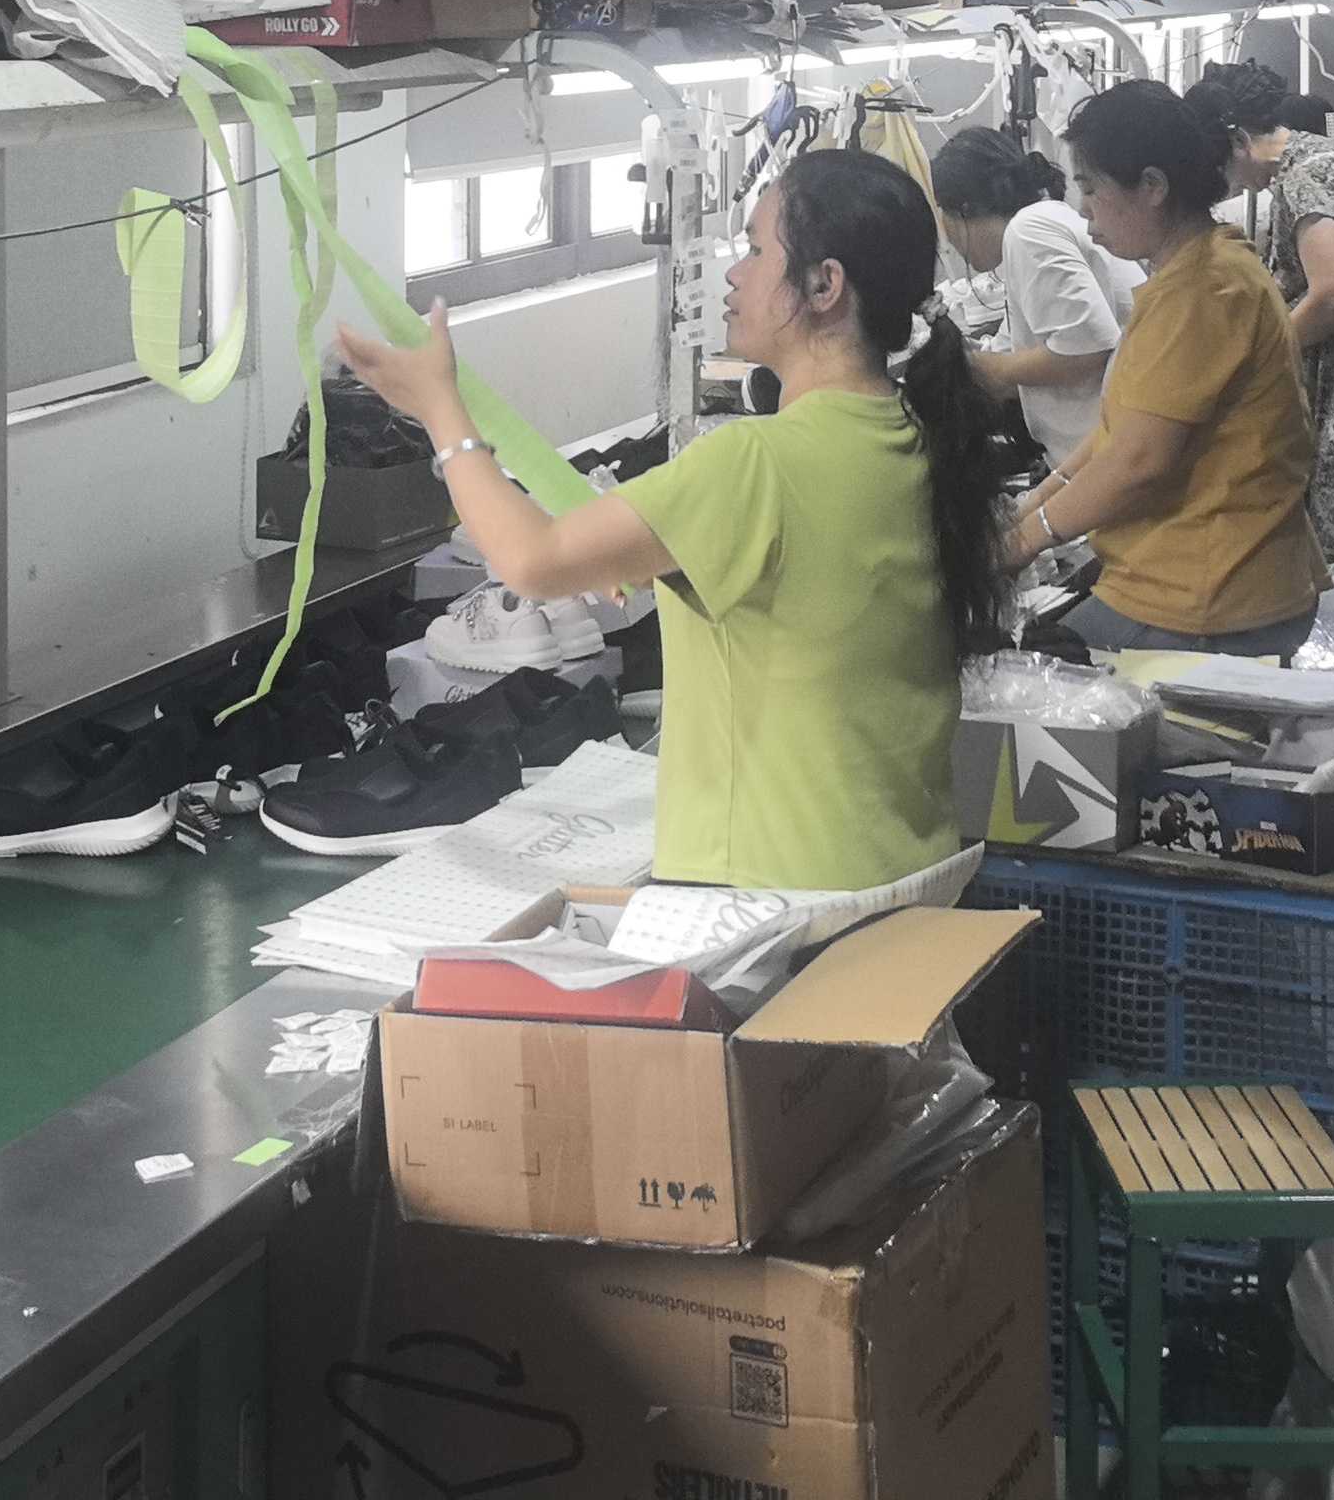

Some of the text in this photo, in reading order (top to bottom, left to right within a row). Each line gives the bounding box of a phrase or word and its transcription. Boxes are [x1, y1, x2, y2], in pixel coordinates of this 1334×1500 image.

[264, 17, 319, 33] ROLLY GO
[460, 1118, 498, 1133] LABEL
[600, 1285, 787, 1332] pactretailsolutions.com
